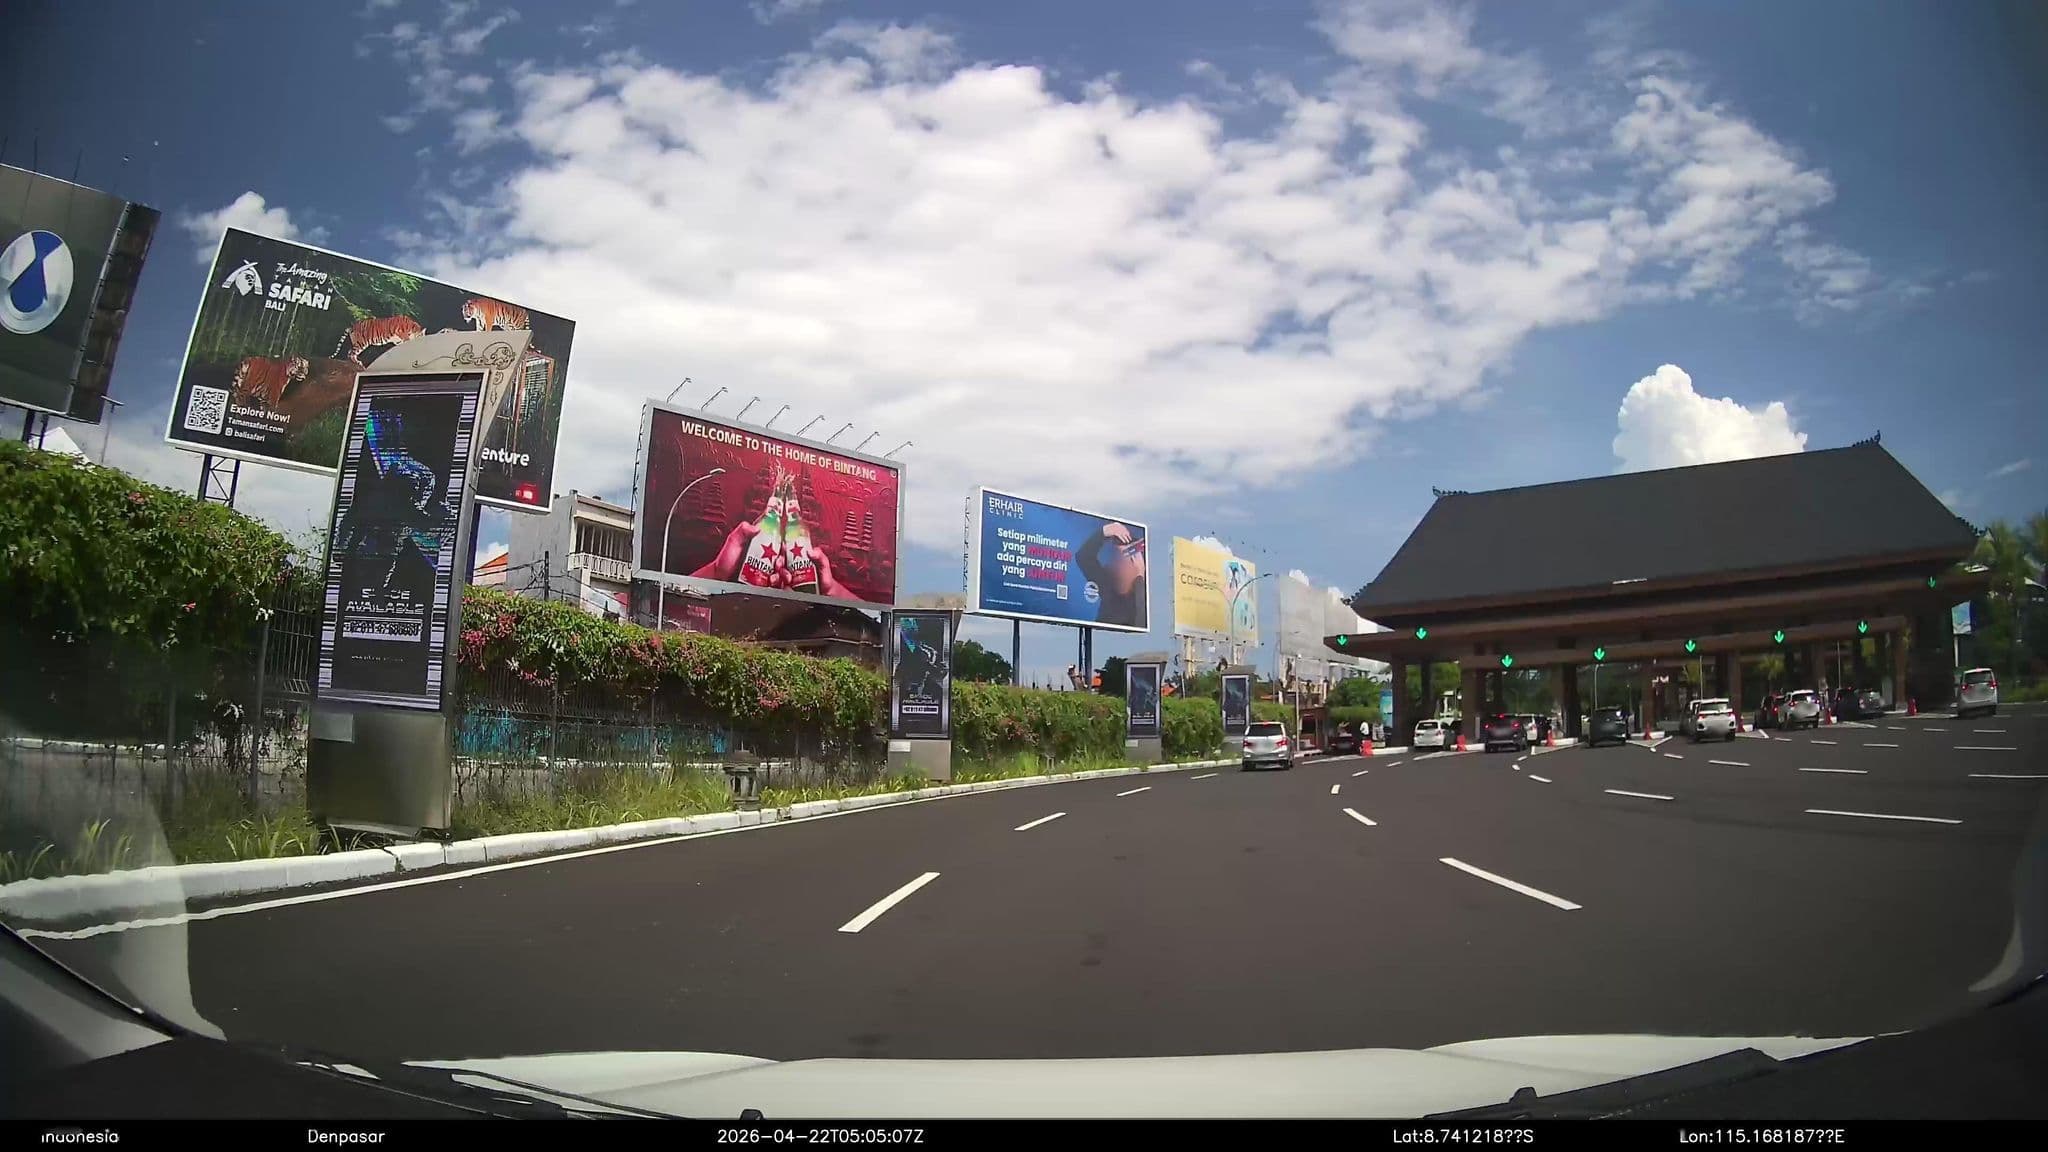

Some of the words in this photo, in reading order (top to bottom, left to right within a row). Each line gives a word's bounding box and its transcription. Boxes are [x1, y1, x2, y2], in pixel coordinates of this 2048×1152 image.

[287, 262, 328, 285] Amazing
[274, 274, 334, 294] TAMAN
[268, 282, 332, 311] SAFARI
[230, 403, 265, 419] Explore
[266, 410, 291, 424] Now!
[481, 446, 530, 467] enture
[681, 420, 743, 447] WELCOME
[745, 437, 760, 451] TO
[761, 441, 783, 457] THE
[785, 446, 817, 466] HOME
[818, 456, 832, 469] OF
[833, 460, 877, 481] BINTANG
[989, 496, 1024, 513] ERHAIR
[989, 508, 1024, 520] CLINIC
[997, 527, 1026, 544] Setiap
[1027, 534, 1068, 549] milimeter
[1002, 541, 1026, 555] yang
[996, 552, 1015, 563] ada
[1016, 556, 1052, 571] percaya
[1053, 561, 1068, 572] diri
[1002, 564, 1026, 578] yang
[344, 600, 425, 615] AVAILABLE
